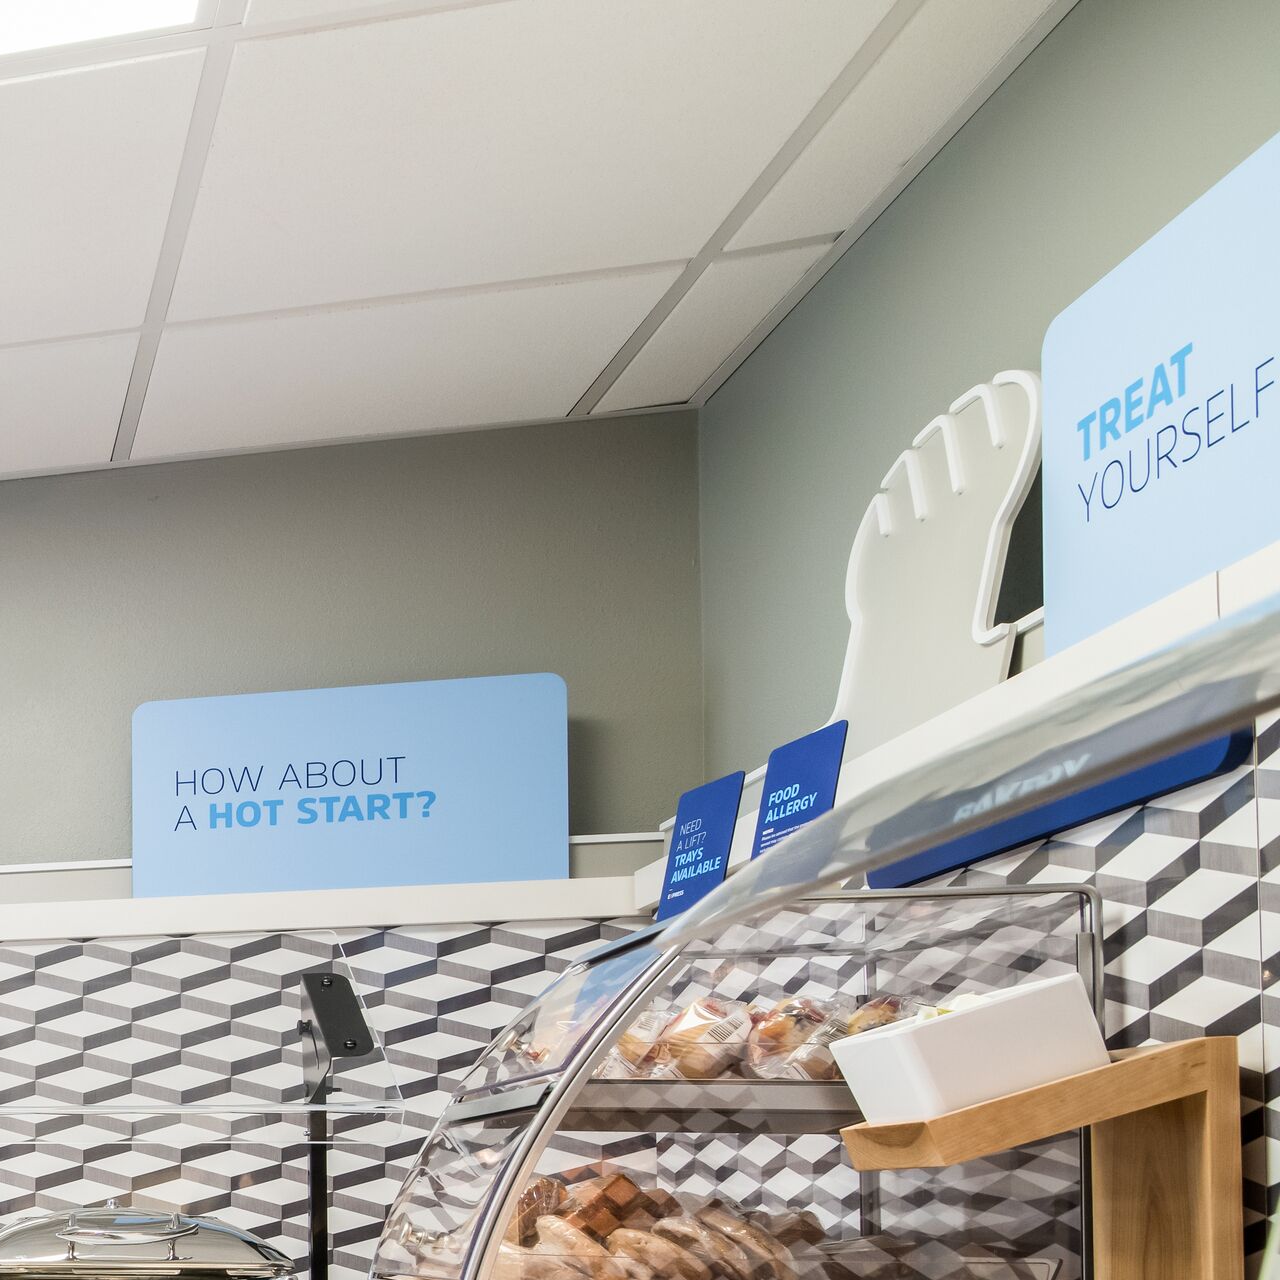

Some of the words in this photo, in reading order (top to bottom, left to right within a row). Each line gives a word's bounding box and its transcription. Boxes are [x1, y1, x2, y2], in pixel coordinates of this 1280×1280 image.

[1077, 342, 1193, 462] TREAT
[1078, 357, 1275, 522] YOURSELF
[176, 765, 264, 796] HOW
[279, 756, 406, 790] ABOUT
[765, 792, 818, 824] ALLERGY
[768, 783, 800, 807] FOOD
[174, 805, 197, 832] A
[209, 800, 284, 829] HOT
[297, 791, 437, 825] START?
[677, 841, 683, 852] A
[685, 831, 707, 850] LIFT?
[679, 818, 702, 836] NEED
[671, 856, 721, 884] AVAILABLE
[675, 847, 704, 868] TRAYS
